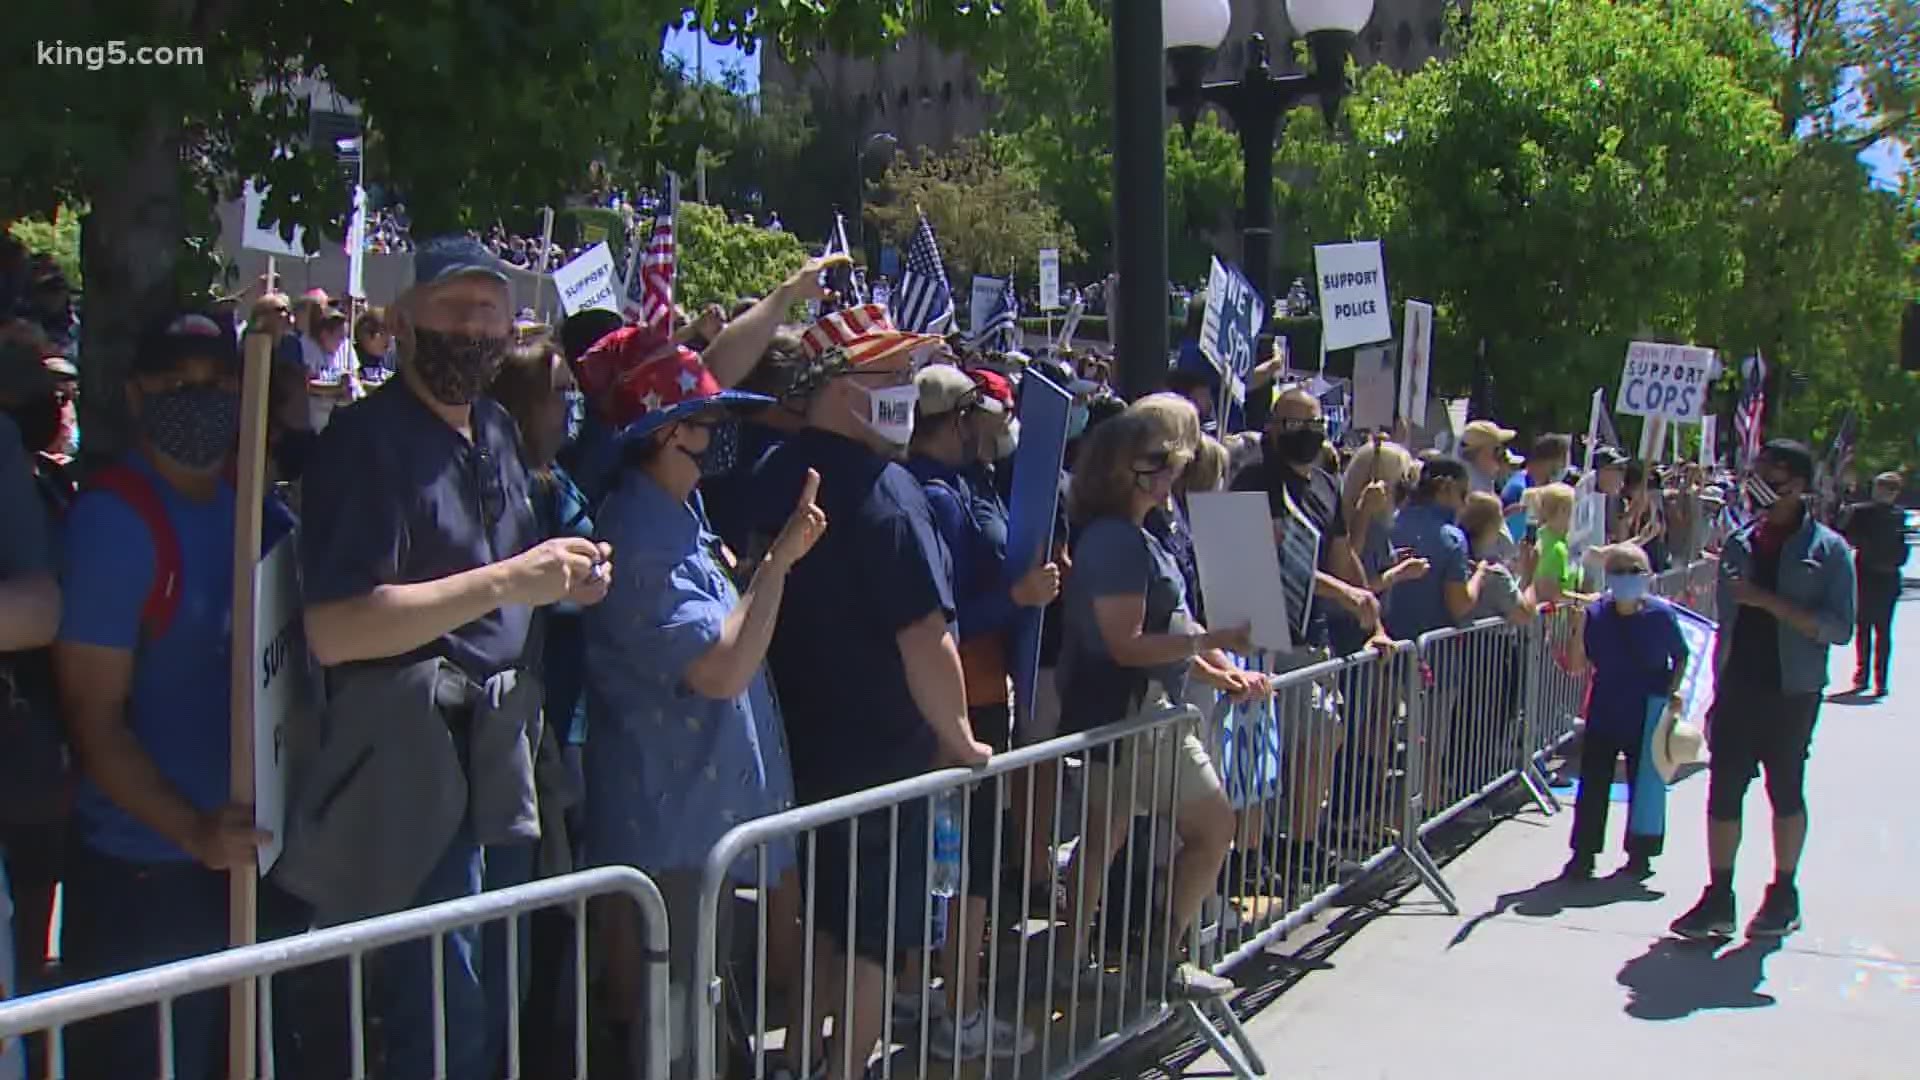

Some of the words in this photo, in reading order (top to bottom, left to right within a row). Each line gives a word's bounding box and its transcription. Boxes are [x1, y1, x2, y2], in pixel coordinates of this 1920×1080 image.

[565, 263, 609, 298] SUPPORT
[1227, 269, 1249, 316] WE
[1323, 271, 1377, 290] SUPPORT
[1334, 300, 1377, 319] POLICE
[1225, 320, 1251, 378] SPD
[1627, 359, 1705, 384] SUPPORT
[1625, 378, 1697, 416] COPS
